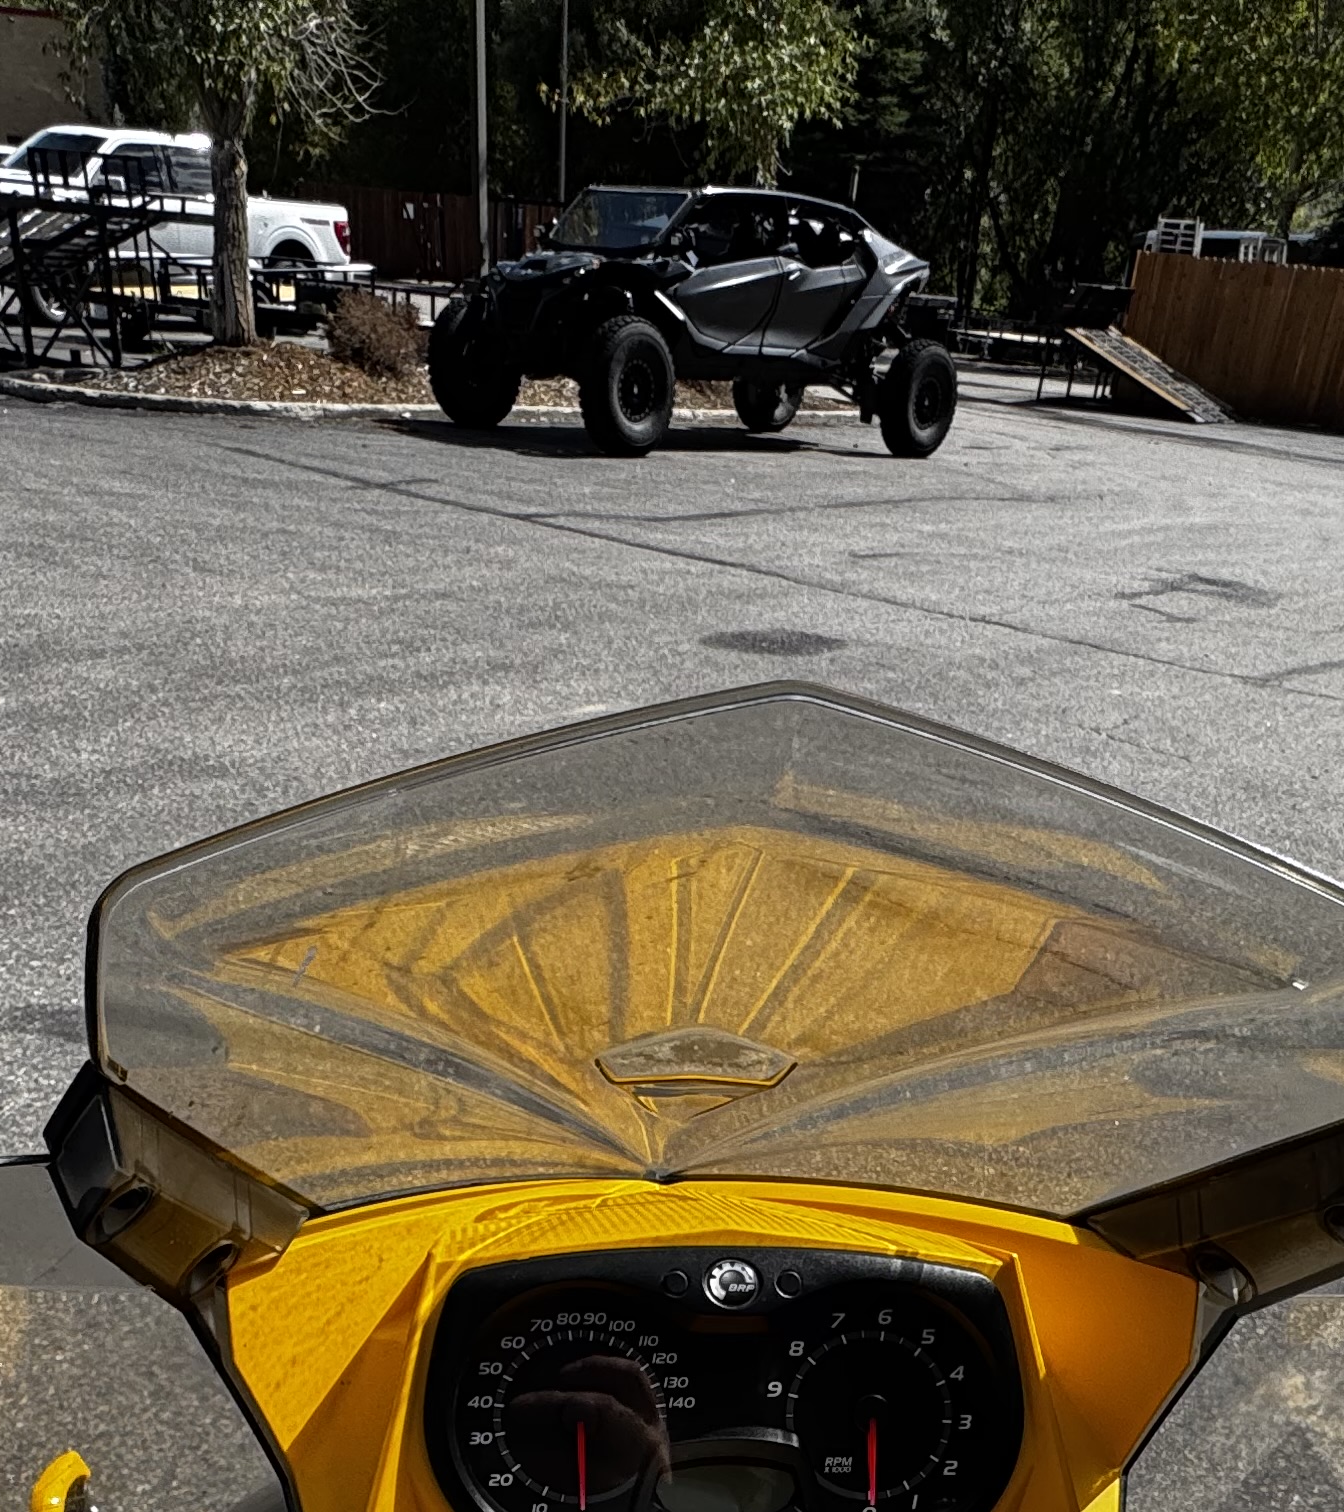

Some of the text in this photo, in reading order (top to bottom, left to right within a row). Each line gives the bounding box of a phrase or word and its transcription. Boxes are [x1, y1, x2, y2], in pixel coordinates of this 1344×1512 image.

[728, 1284, 756, 1292] BRP
[556, 1312, 581, 1325] 80
[583, 1312, 607, 1325] 90
[831, 1312, 846, 1328] 7
[877, 1309, 894, 1325] 6
[530, 1319, 554, 1332] 70
[608, 1320, 636, 1332] 100
[500, 1336, 526, 1349] 60
[639, 1336, 659, 1347] 110
[920, 1328, 936, 1344] 5
[788, 1341, 805, 1356] 8
[652, 1353, 678, 1364] 120
[478, 1362, 503, 1375] 50
[949, 1366, 965, 1381] 4
[663, 1377, 689, 1388] 130
[767, 1381, 783, 1397] 9
[467, 1396, 493, 1408] 40
[668, 1397, 696, 1408] 140
[958, 1414, 973, 1429] 3
[469, 1432, 493, 1445] 30
[825, 1457, 853, 1466] RPM
[943, 1460, 958, 1476] 2
[488, 1474, 513, 1486] 20
[912, 1494, 918, 1510] 1
